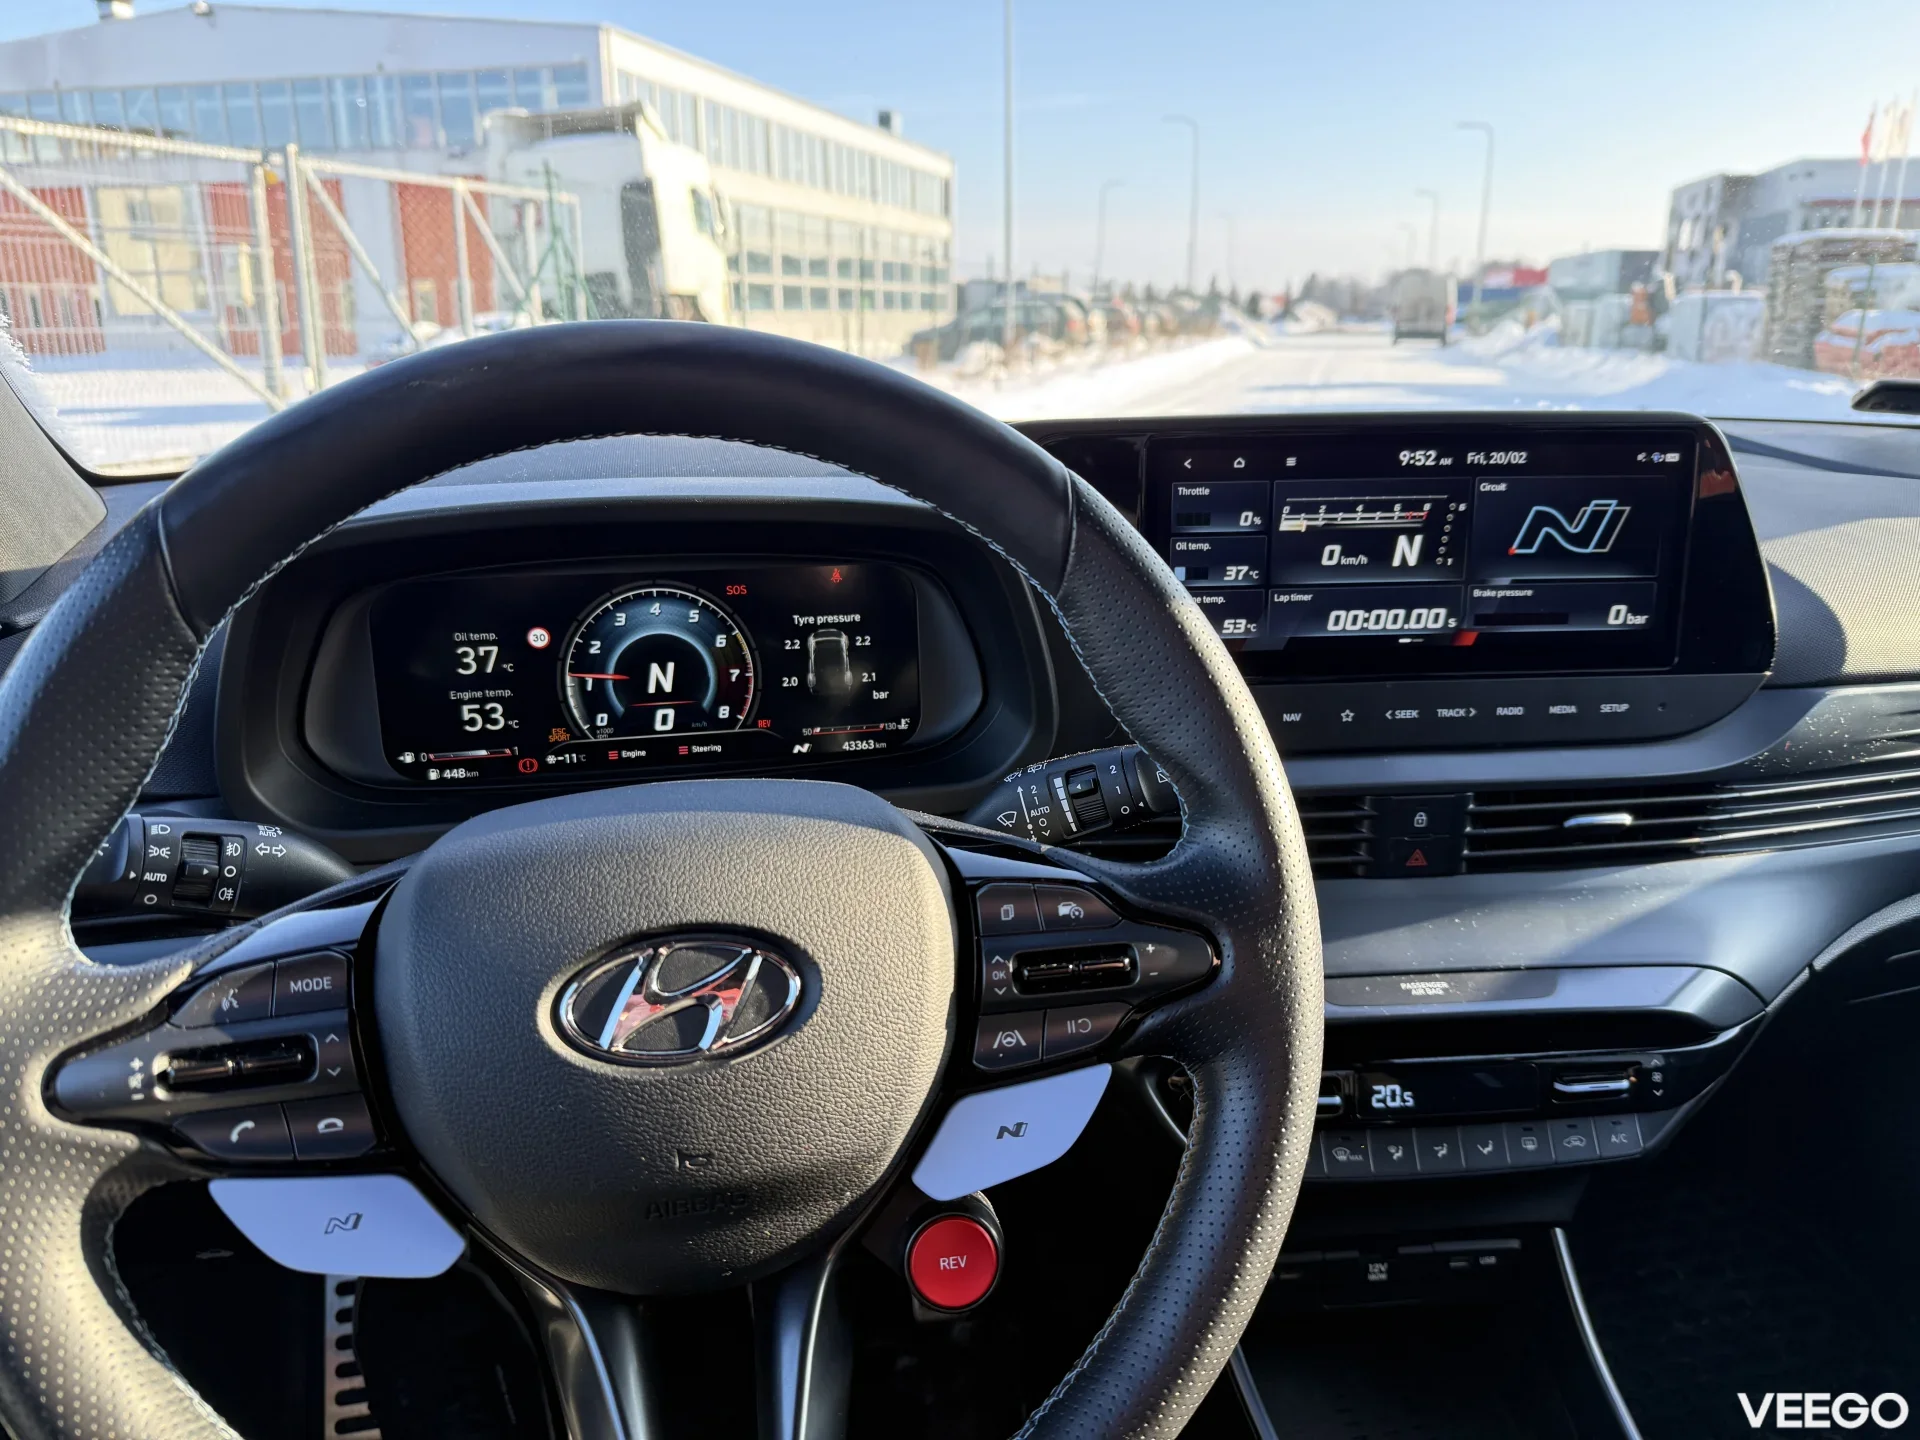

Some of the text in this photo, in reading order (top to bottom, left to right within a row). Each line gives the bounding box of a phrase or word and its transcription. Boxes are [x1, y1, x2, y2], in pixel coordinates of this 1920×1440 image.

[1399, 449, 1454, 467] 9:52 AM
[1489, 451, 1528, 465] 20/02
[1178, 486, 1210, 496] Throttle
[1480, 482, 1508, 492] Circuit
[1319, 505, 1327, 513] 2
[1356, 504, 1364, 512] 4
[1393, 503, 1401, 511] 6
[1175, 541, 1211, 552] Oil temp.
[1391, 534, 1424, 567] N
[1321, 544, 1368, 566] 0 km/h
[1224, 565, 1248, 581] 37
[726, 585, 747, 596] SOS
[1473, 588, 1534, 598] Brake pressure
[1203, 595, 1226, 604] temp.
[1274, 592, 1313, 603] Lap timer
[650, 603, 661, 616] 4
[1607, 604, 1649, 625] 0 bar
[615, 613, 626, 626] 3
[688, 610, 700, 623] 5
[792, 613, 861, 626] Tyre pressure
[1327, 607, 1447, 631] 00:00.00
[1222, 618, 1247, 634] 53
[454, 631, 498, 643] Oil temp.
[533, 633, 546, 642] 30
[715, 635, 727, 648] 6
[855, 636, 871, 646] 2.2
[589, 641, 601, 654] 2
[784, 639, 800, 650] 2.2
[456, 645, 499, 675] 37
[647, 662, 675, 694] N
[729, 669, 740, 682] 7
[861, 673, 876, 683] 2.1
[585, 677, 593, 691] 1
[782, 677, 798, 687] 2.0
[450, 688, 514, 702] Engine temp.
[872, 689, 889, 700] bar
[718, 705, 730, 719] 8
[1437, 708, 1466, 718] TRACK
[1496, 706, 1525, 716] RADIO
[1549, 705, 1577, 714] MEDIA
[1600, 703, 1630, 713] SETUP
[460, 702, 505, 732] 53
[654, 708, 675, 731] 0
[1282, 713, 1302, 722] NAV
[1394, 709, 1420, 719] SEEK
[596, 713, 608, 727] 0
[757, 719, 771, 728] REV
[552, 727, 566, 735] ESC
[884, 722, 897, 730] 130
[549, 734, 570, 742] SPORT
[802, 728, 812, 737] 50
[692, 744, 721, 753] Steering
[842, 739, 875, 751] 43363
[420, 752, 428, 762] 0
[621, 750, 646, 758] Engine
[443, 768, 466, 779] 448
[1109, 765, 1117, 774] 2
[1030, 785, 1038, 794] 2
[1115, 785, 1121, 795] 1
[1034, 797, 1039, 805] 1
[1030, 805, 1050, 818] AUTO
[259, 830, 277, 838] AUTO
[143, 872, 167, 882] AUTO
[992, 970, 1007, 980] OK
[289, 976, 332, 993] MODE
[1400, 981, 1450, 990] PASSENGER
[1371, 1084, 1414, 1108] 20.5
[1610, 1133, 1628, 1143] A/C
[645, 1191, 749, 1221] AIRBAG
[939, 1255, 967, 1270] REV
[1368, 1262, 1388, 1272] 12V
